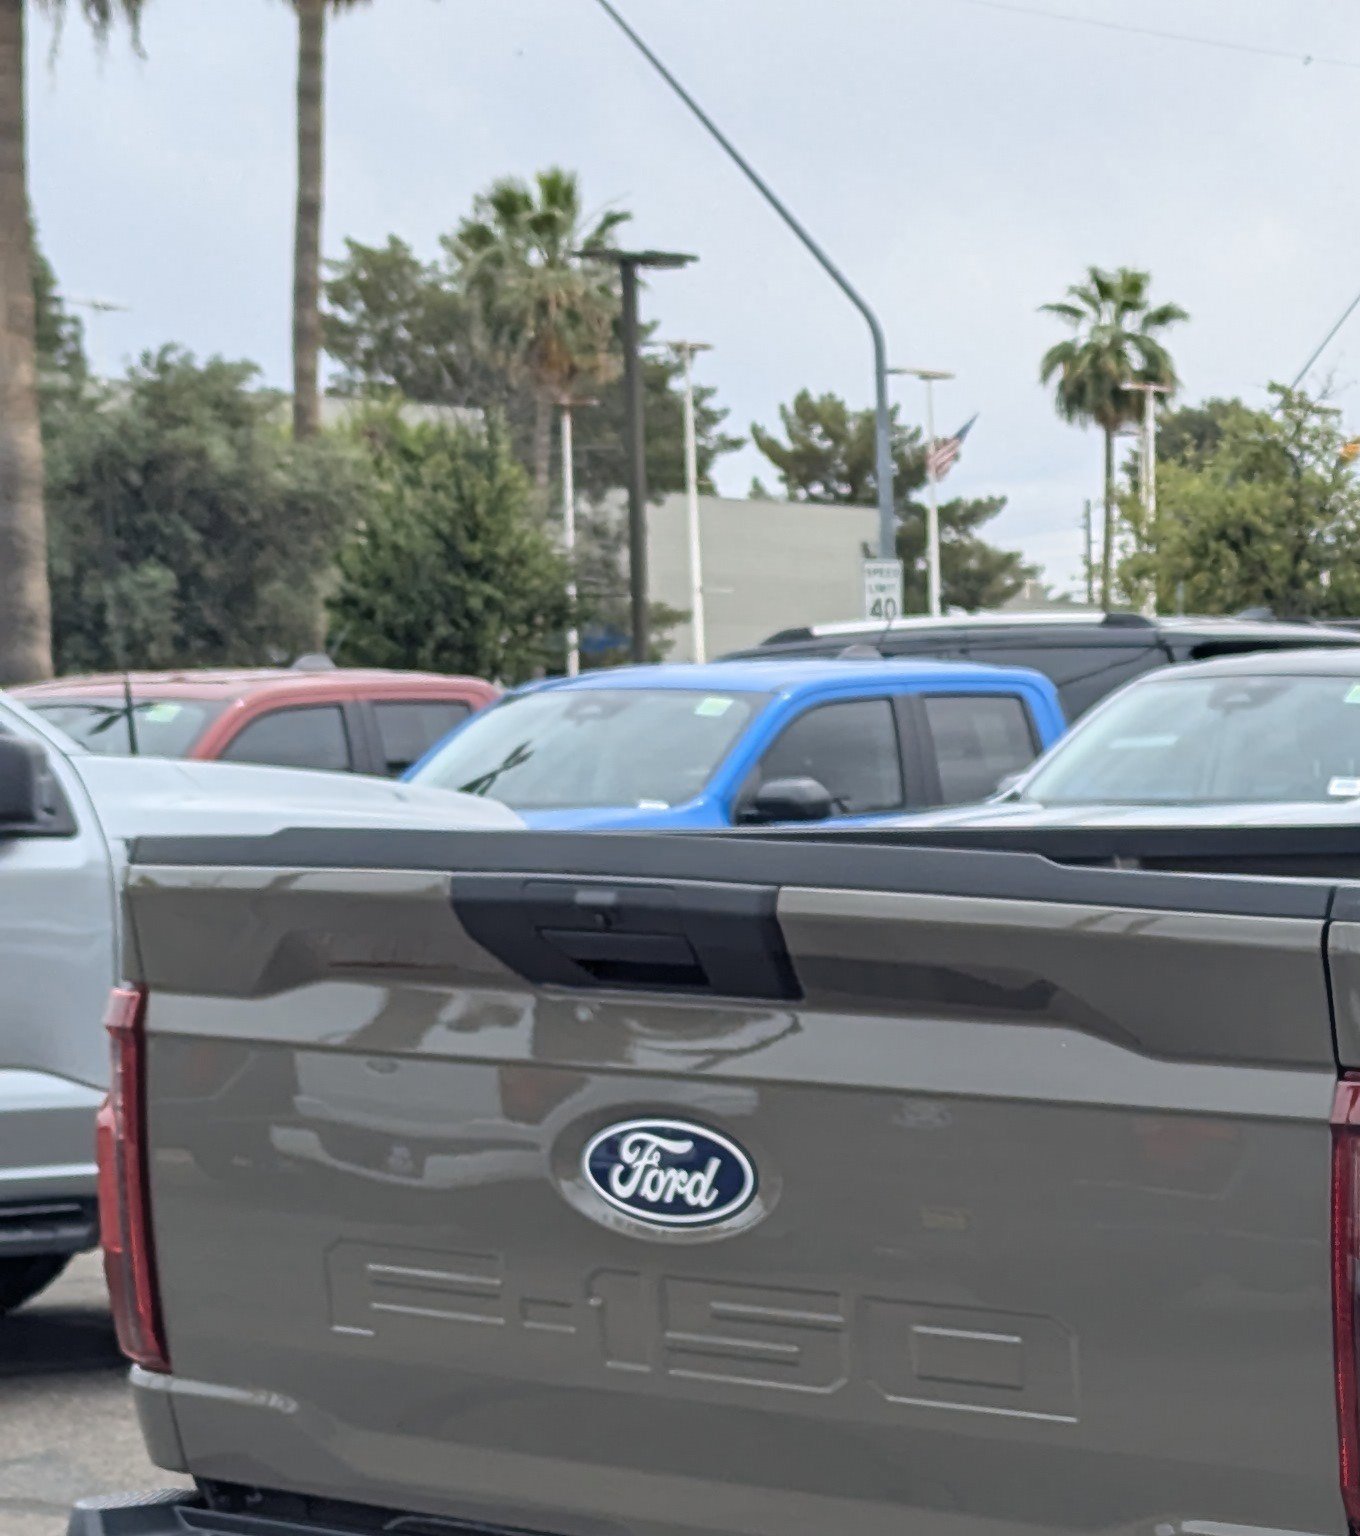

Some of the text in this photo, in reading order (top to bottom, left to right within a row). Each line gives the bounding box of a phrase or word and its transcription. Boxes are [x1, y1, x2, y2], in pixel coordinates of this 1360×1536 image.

[870, 598, 897, 619] 40
[609, 1131, 722, 1208] Ford
[324, 1237, 1080, 1423] F-150
